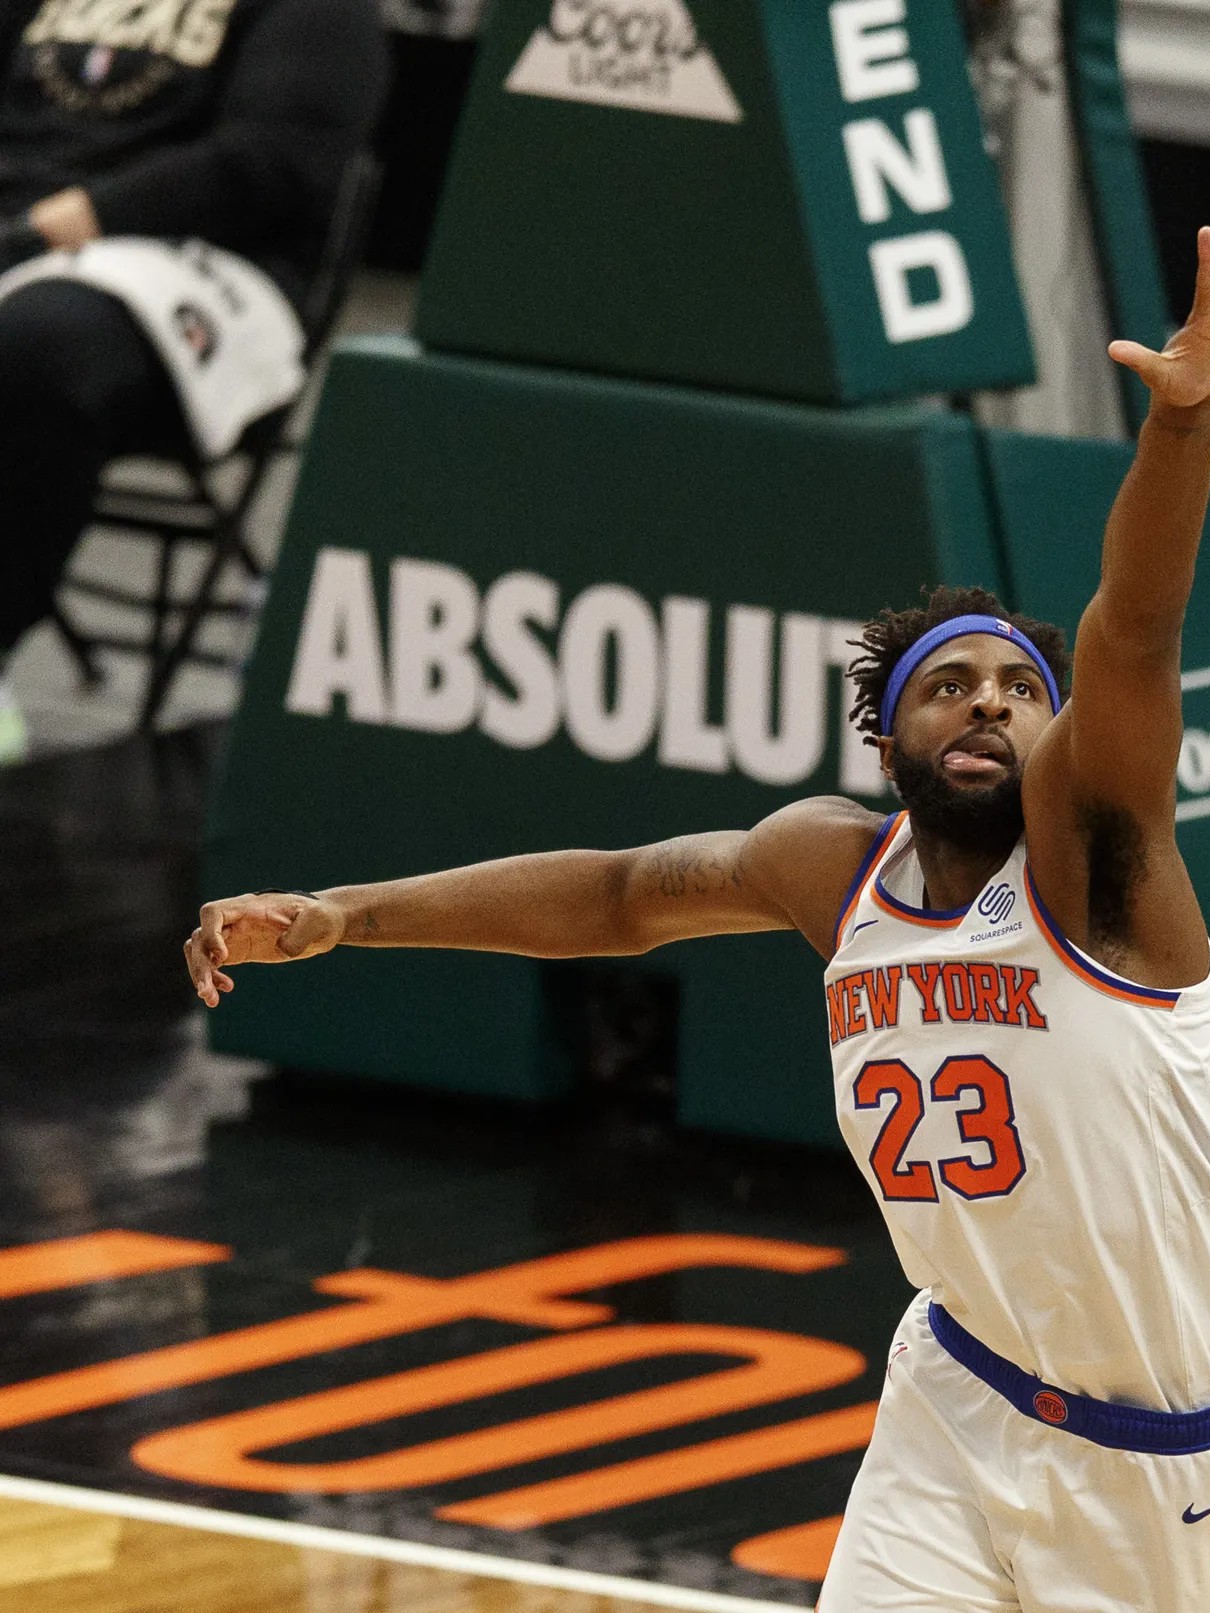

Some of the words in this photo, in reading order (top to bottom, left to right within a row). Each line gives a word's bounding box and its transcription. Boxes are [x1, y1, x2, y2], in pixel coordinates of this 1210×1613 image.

[566, 50, 674, 98] LIGHT
[284, 545, 893, 798] ABSOLUT
[969, 920, 1023, 943] SQUARESPACE
[826, 964, 903, 1048] NEW
[905, 960, 1051, 1032] YORK
[853, 1054, 1027, 1203] 23
